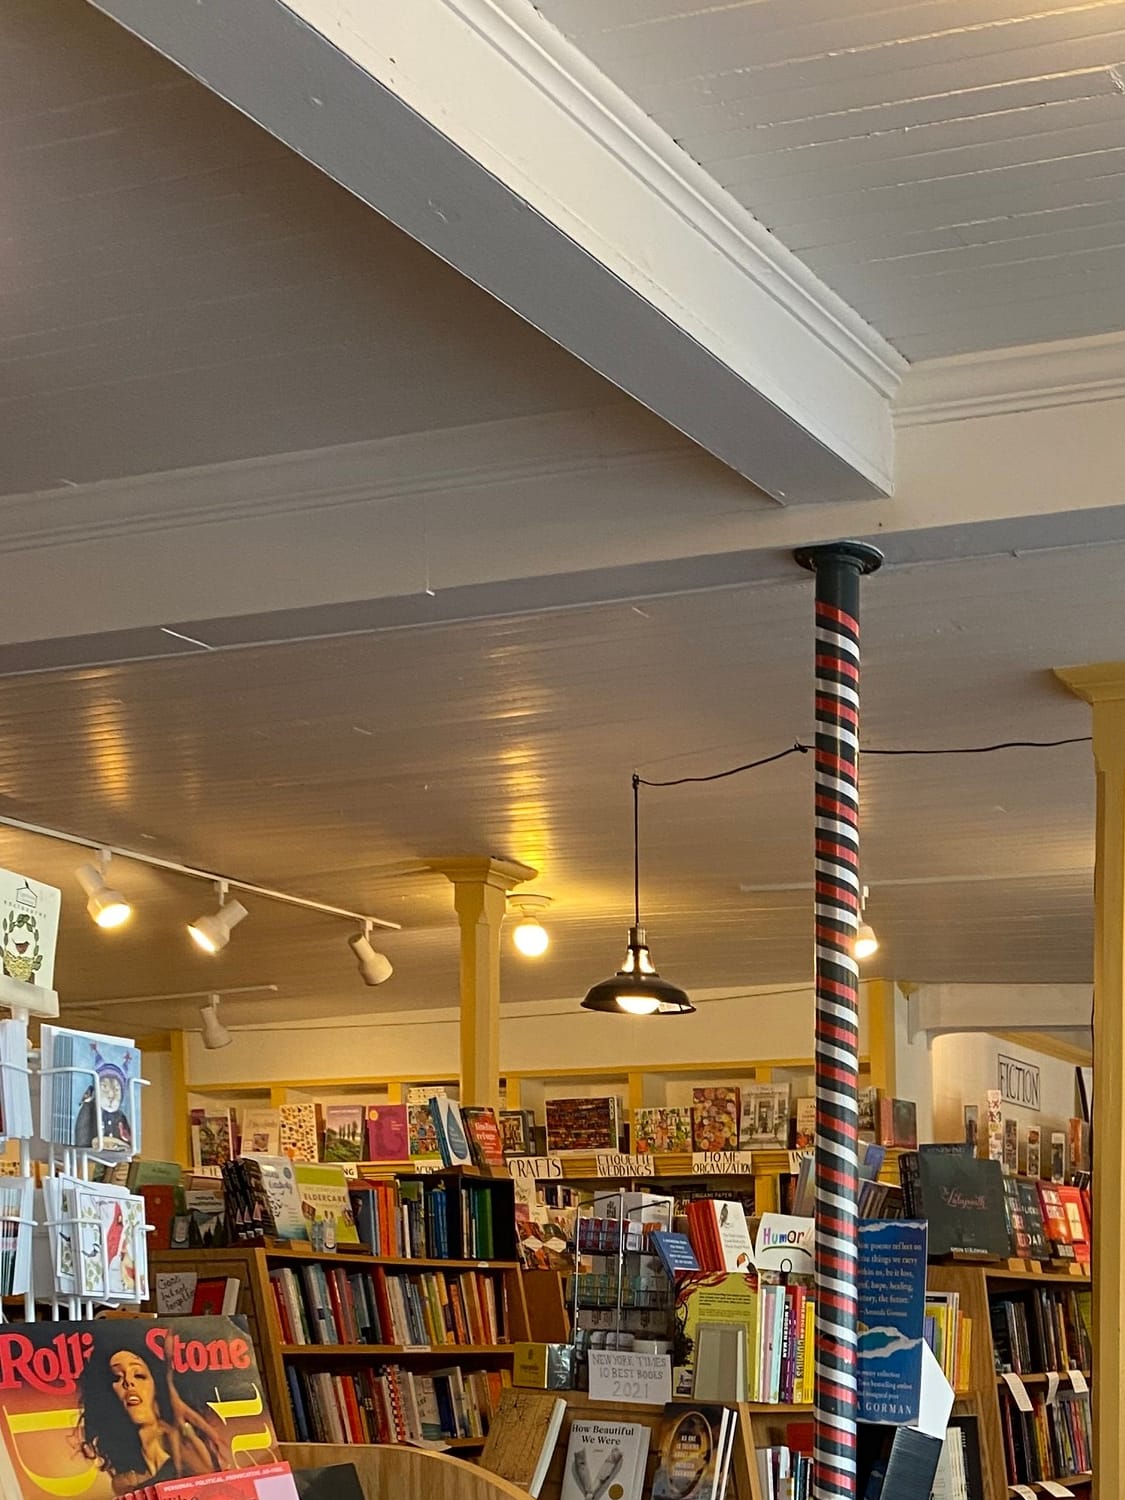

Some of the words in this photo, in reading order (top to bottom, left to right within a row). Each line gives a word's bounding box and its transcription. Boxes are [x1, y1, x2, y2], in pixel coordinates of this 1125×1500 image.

[999, 1062, 1040, 1106] FICTION
[597, 1154, 650, 1166] ETIQUETTE
[703, 1151, 741, 1163] HOME
[508, 1158, 561, 1179] CRAFTS
[599, 1164, 652, 1177] WEDDINGS
[782, 1311, 790, 1341] MODERN
[0, 1331, 95, 1395] Rolli
[592, 1353, 612, 1366] NEW
[613, 1354, 635, 1367] YORK
[637, 1356, 666, 1367] TIMES
[599, 1367, 611, 1378] 10
[611, 1367, 635, 1379] BEST
[637, 1370, 664, 1380] BOOKS
[612, 1380, 649, 1399] 2021
[865, 1402, 913, 1415] GORMAN
[572, 1423, 589, 1436] How
[590, 1424, 636, 1437] Beautiful
[581, 1434, 596, 1446] We
[598, 1435, 621, 1447] Were
